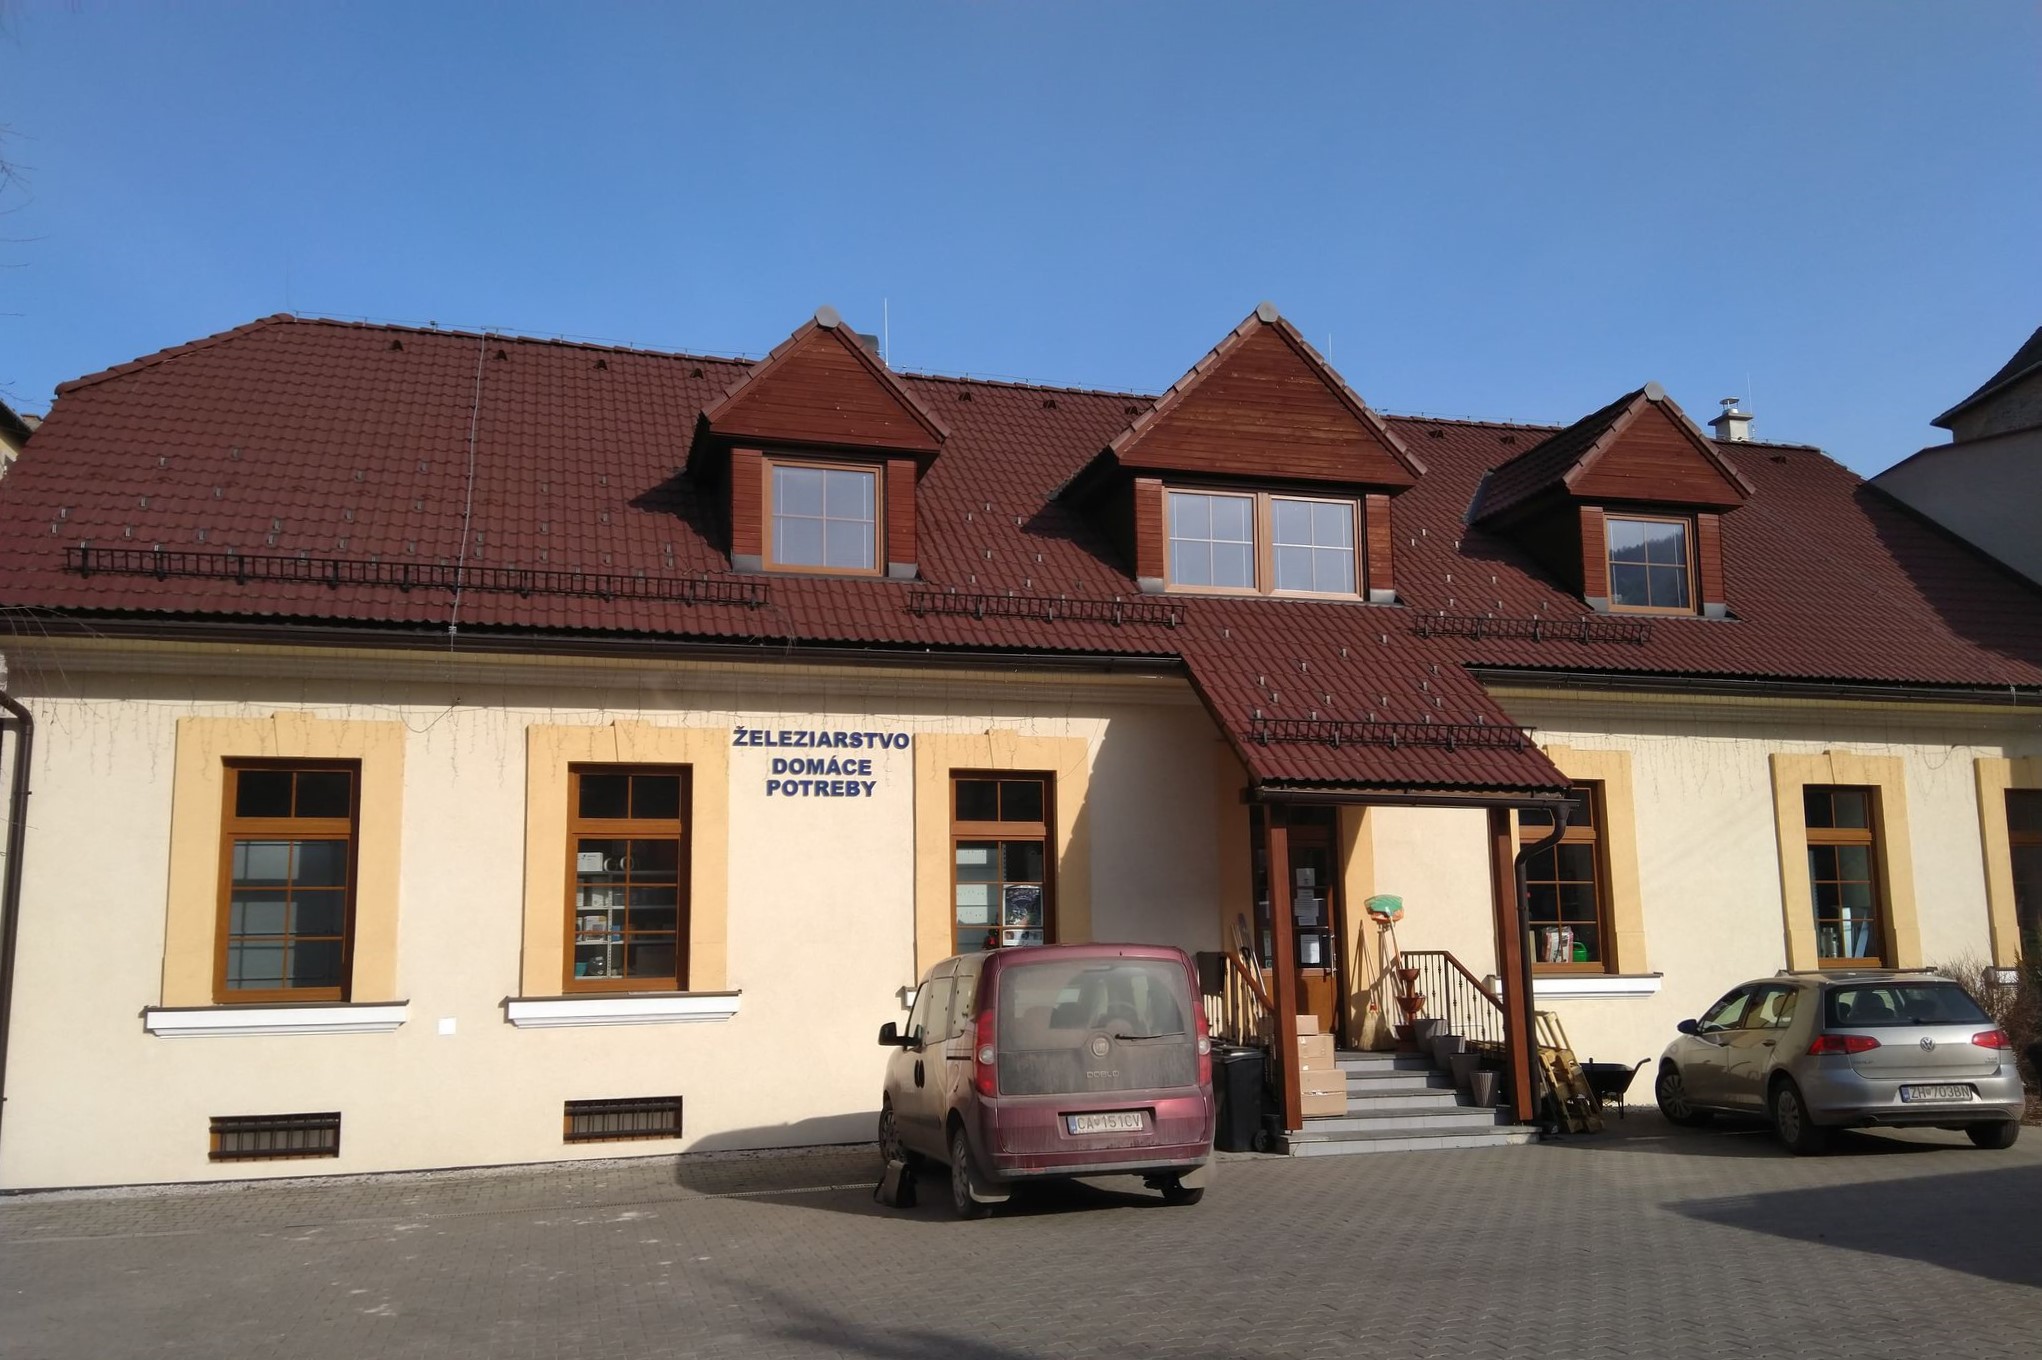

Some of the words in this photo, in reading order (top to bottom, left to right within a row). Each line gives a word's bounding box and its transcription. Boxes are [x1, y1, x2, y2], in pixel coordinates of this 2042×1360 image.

[732, 726, 910, 749] ŽELEZIARSTVO
[772, 755, 872, 776] DOMÁCE
[766, 779, 877, 797] POTREBY
